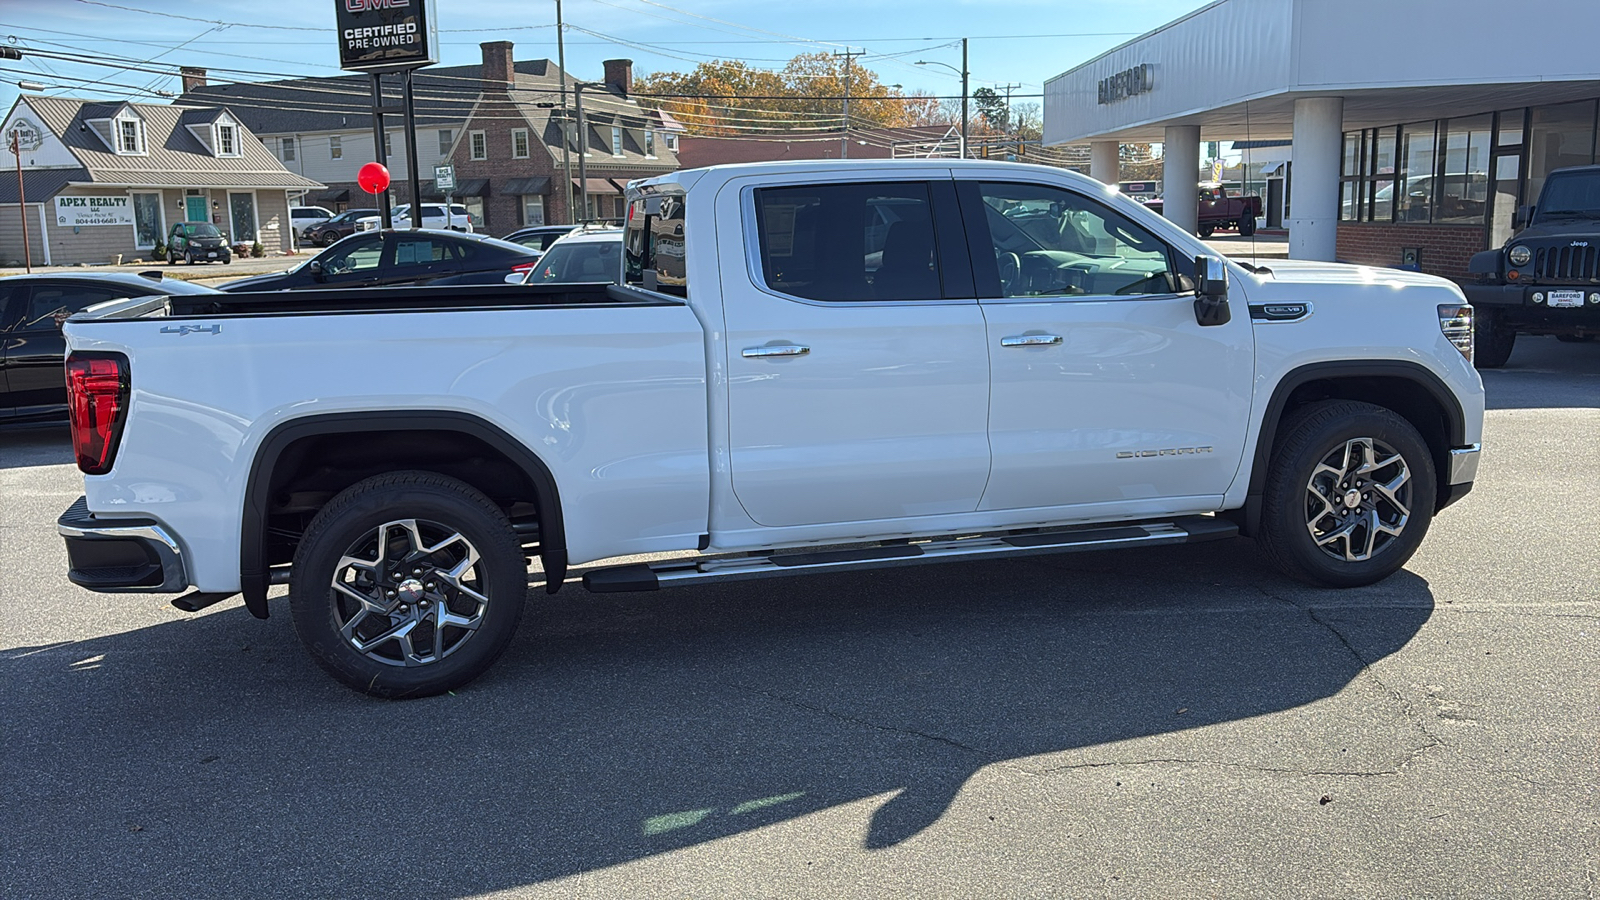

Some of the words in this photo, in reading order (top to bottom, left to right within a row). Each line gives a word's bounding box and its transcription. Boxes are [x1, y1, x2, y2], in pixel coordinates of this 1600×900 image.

[344, 23, 417, 40] CERTIFIED
[348, 34, 414, 50] PRE-OWNED
[1098, 63, 1154, 105] BAREFORD
[60, 198, 87, 206] APEX
[90, 198, 127, 206] REALTY
[1570, 240, 1588, 248] Jeep
[1116, 446, 1213, 459] SIERRA
